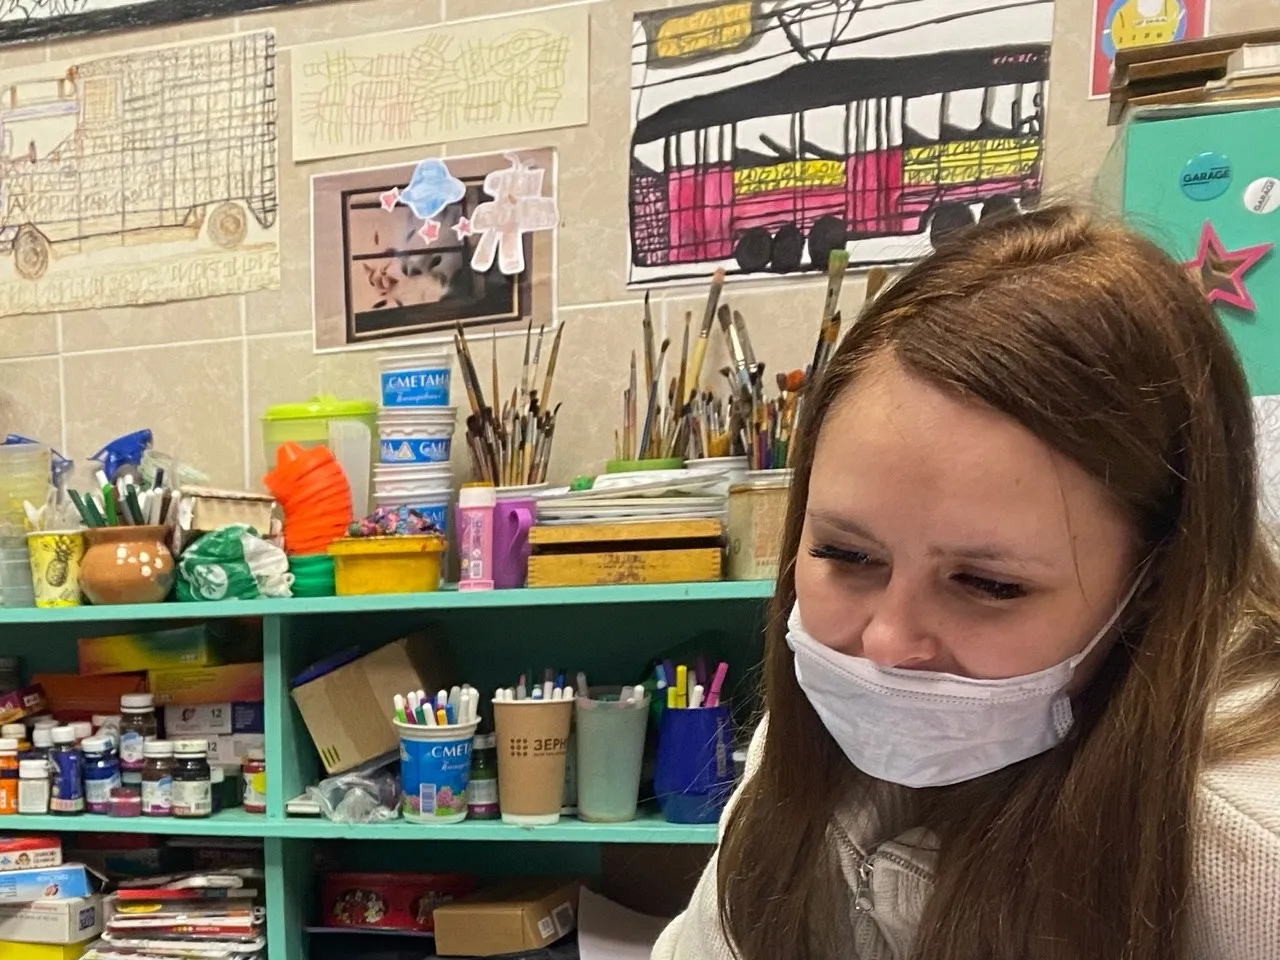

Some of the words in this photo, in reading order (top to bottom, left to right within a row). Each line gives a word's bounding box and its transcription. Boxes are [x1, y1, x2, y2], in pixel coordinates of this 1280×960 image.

[1183, 170, 1231, 183] GARAGE
[1253, 179, 1276, 212] GARAGE
[211, 708, 222, 718] 12
[207, 741, 217, 752] 12
